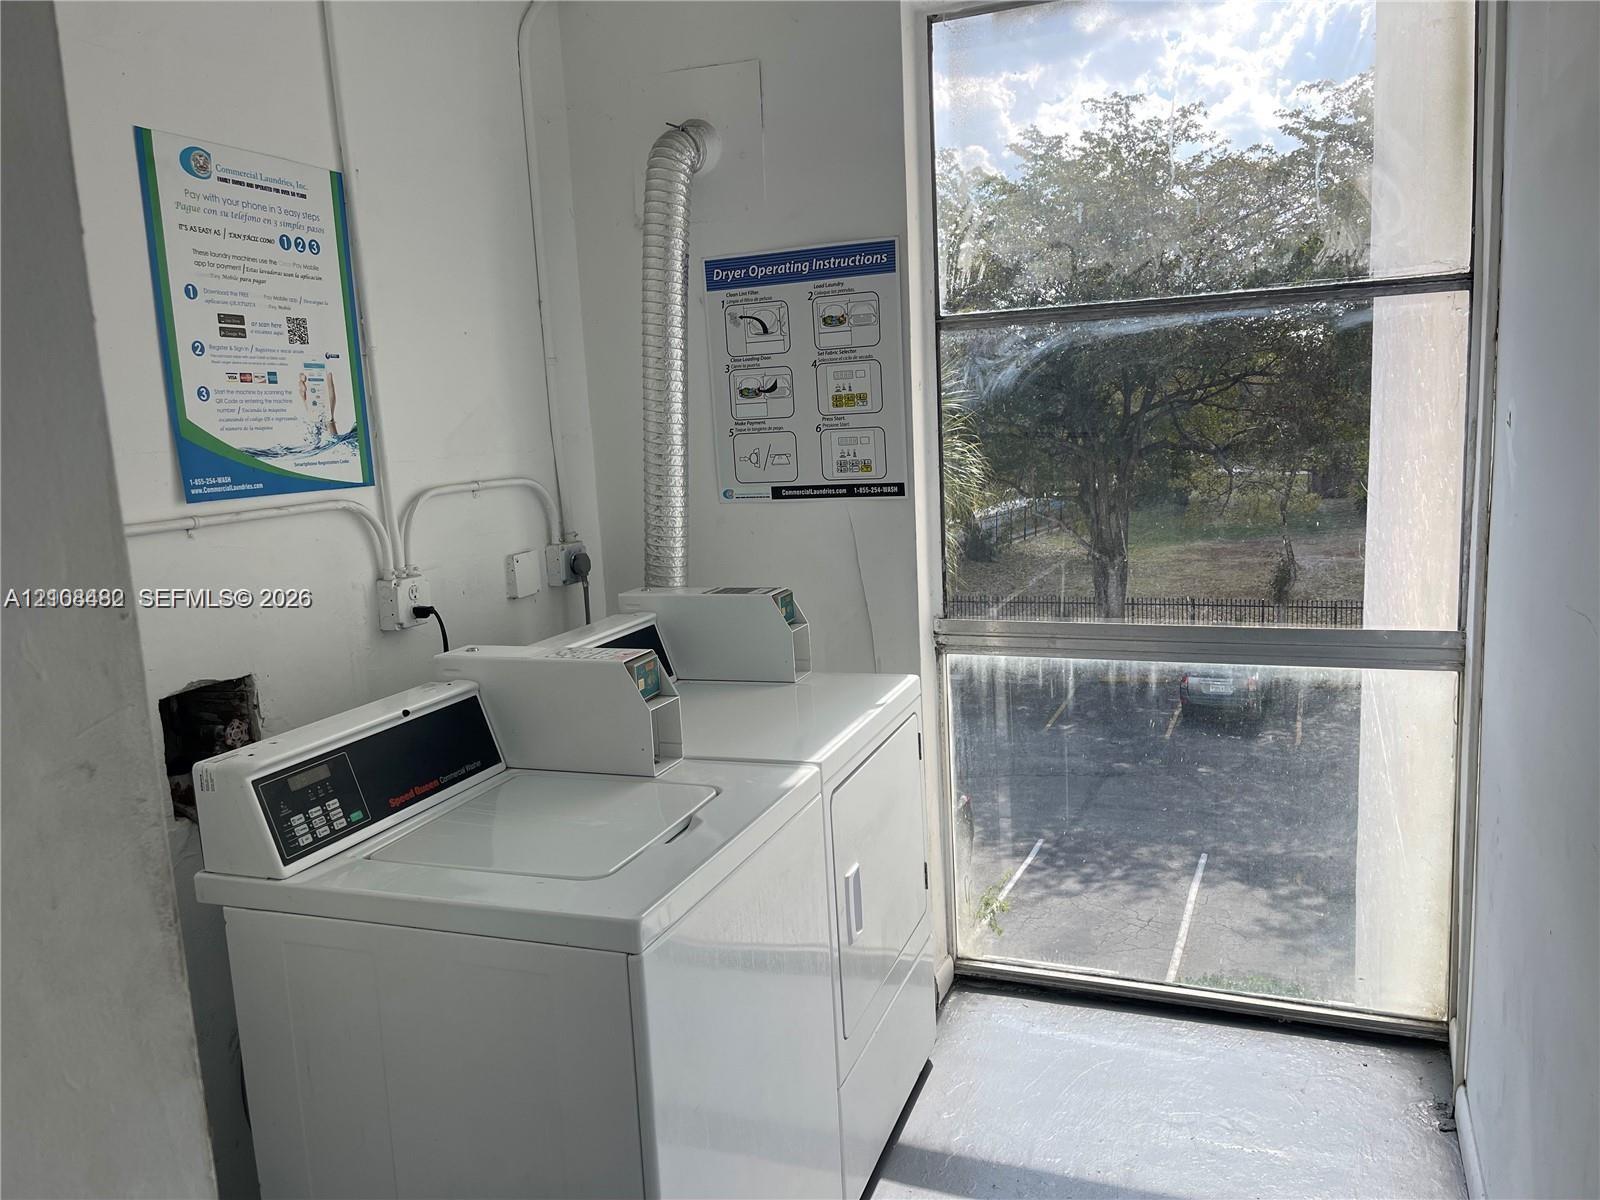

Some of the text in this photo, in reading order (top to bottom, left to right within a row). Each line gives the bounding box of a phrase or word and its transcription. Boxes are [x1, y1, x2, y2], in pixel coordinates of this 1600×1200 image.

[216, 164, 308, 190] Commercial Laundries, Inc.
[184, 189, 320, 222] Pay with your phone in 3 easy steps
[175, 201, 201, 214] Pague
[203, 207, 217, 215] con
[220, 210, 229, 218] su
[279, 218, 305, 232] simples
[306, 224, 325, 234] pasos
[199, 226, 212, 235] EASY
[213, 228, 221, 236] AS
[192, 248, 209, 257] These
[210, 250, 230, 261] laundry
[232, 254, 257, 264] machines
[194, 260, 206, 269] app
[207, 261, 215, 269] for
[217, 263, 241, 271] payment
[713, 252, 887, 282] Dryer Operating Instructions
[825, 281, 844, 289] Laundry
[203, 288, 229, 296] Download
[808, 292, 813, 301] 2
[721, 300, 725, 309] 1
[270, 321, 282, 329] here
[811, 360, 817, 368] 4
[725, 365, 730, 374] 3
[816, 424, 821, 432] 6
[729, 429, 734, 437] 5
[190, 477, 232, 486] 1-855-254-WASH
[191, 482, 264, 495] www.CommercialLaundries.com
[782, 488, 847, 496] CommercialLaundries.com
[389, 788, 415, 807] Speed
[415, 779, 440, 795] Queen
[440, 767, 466, 783] Commercial
